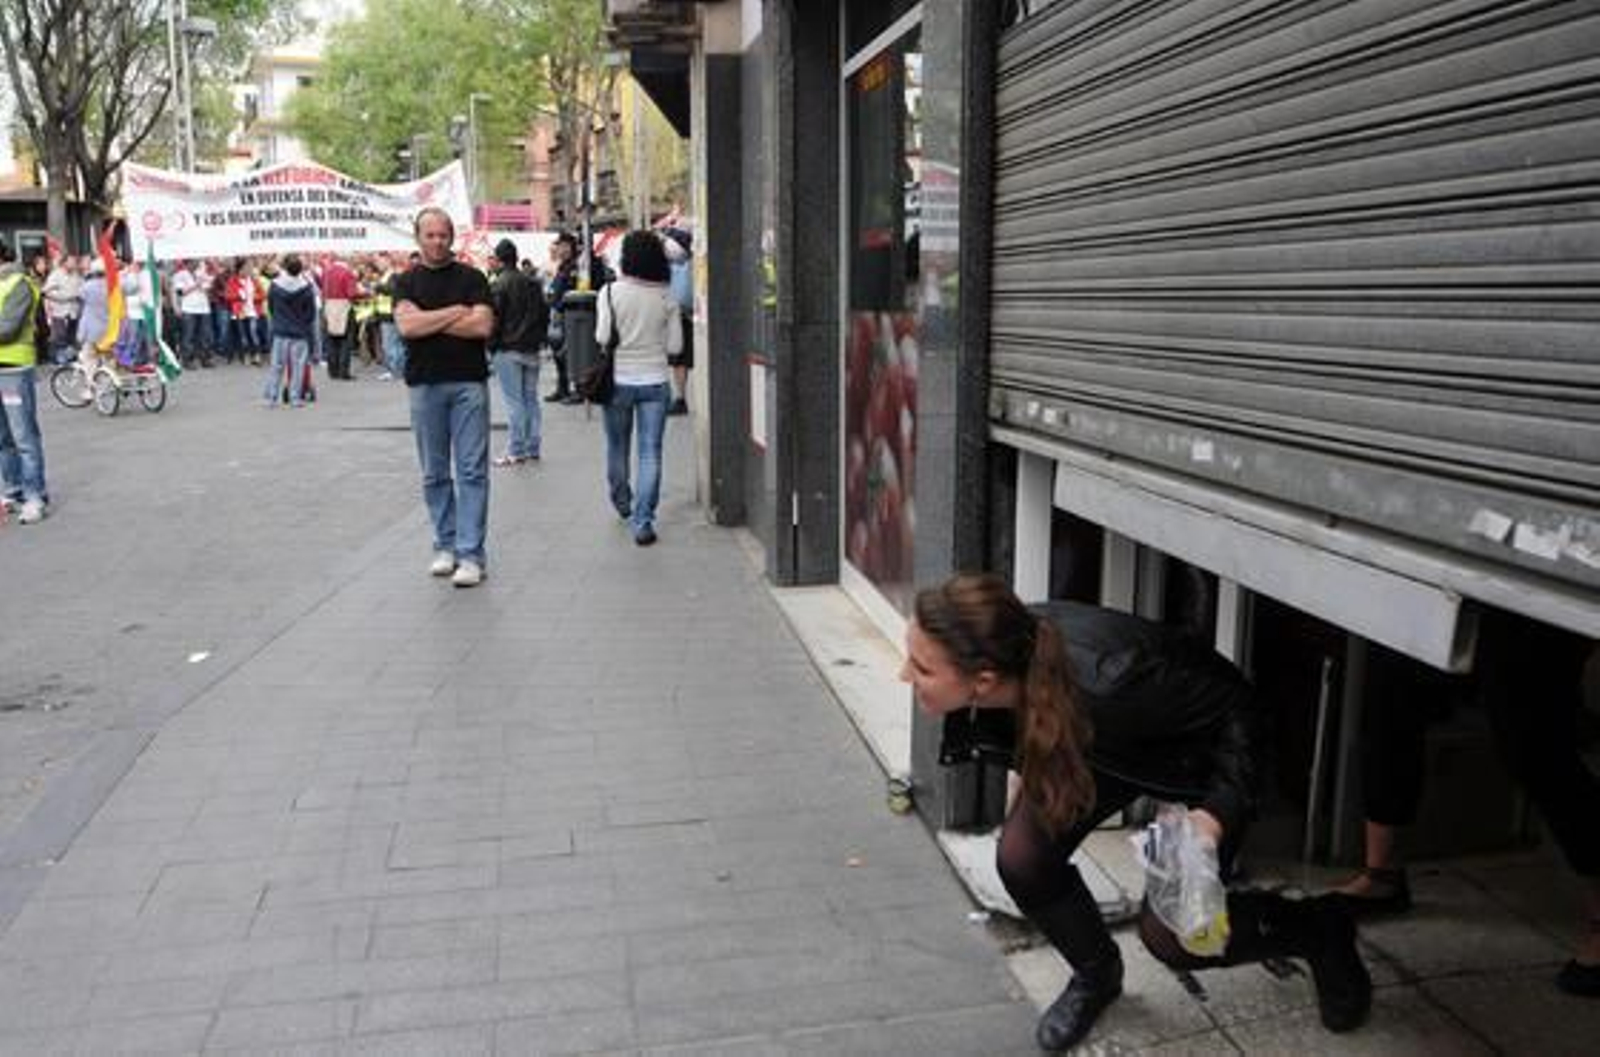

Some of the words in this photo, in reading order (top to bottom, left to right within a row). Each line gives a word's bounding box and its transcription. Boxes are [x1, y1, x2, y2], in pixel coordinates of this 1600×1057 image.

[193, 213, 199, 226] Y
[204, 212, 225, 226] LOS
[304, 207, 325, 221] LOS
